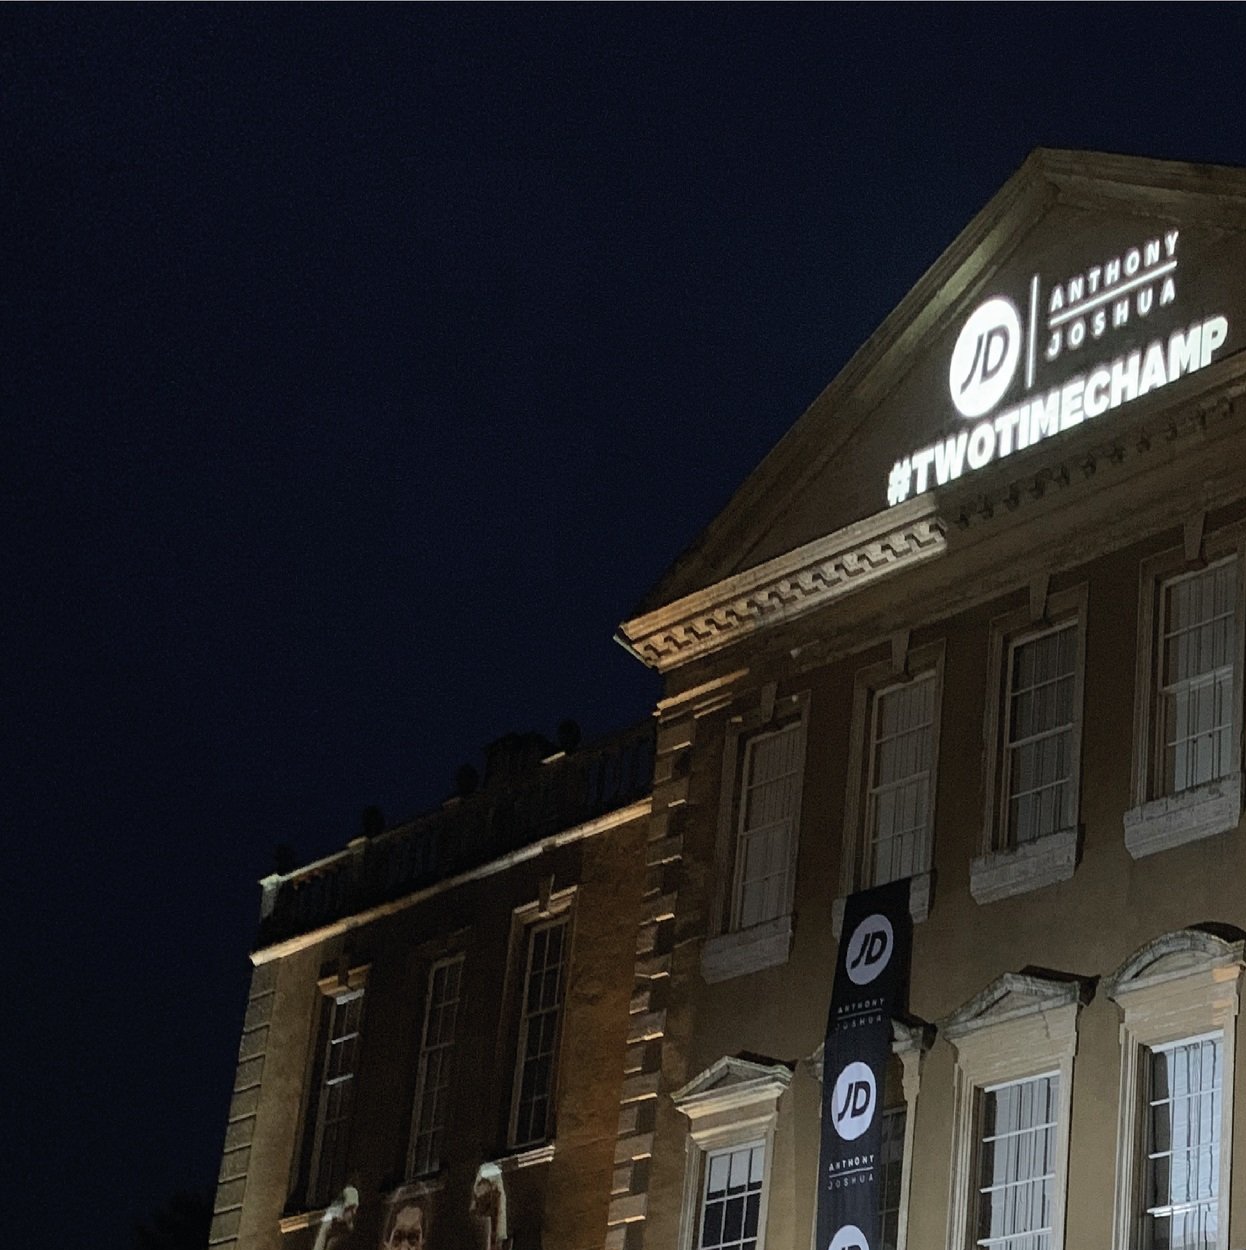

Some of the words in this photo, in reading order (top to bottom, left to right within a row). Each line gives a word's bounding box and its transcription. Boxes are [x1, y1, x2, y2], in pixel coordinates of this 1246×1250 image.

[1049, 229, 1180, 312] ANTHONY
[1045, 278, 1177, 361] JOSHUA
[960, 324, 1010, 396] JD
[886, 314, 1230, 507] #TWOTIMECHAMP
[850, 930, 888, 970] JD
[837, 998, 885, 1014] ANTHONY
[837, 1081, 871, 1123] JD
[827, 1173, 874, 1190] JOSHUA
[828, 1154, 875, 1172] ANTHONY
